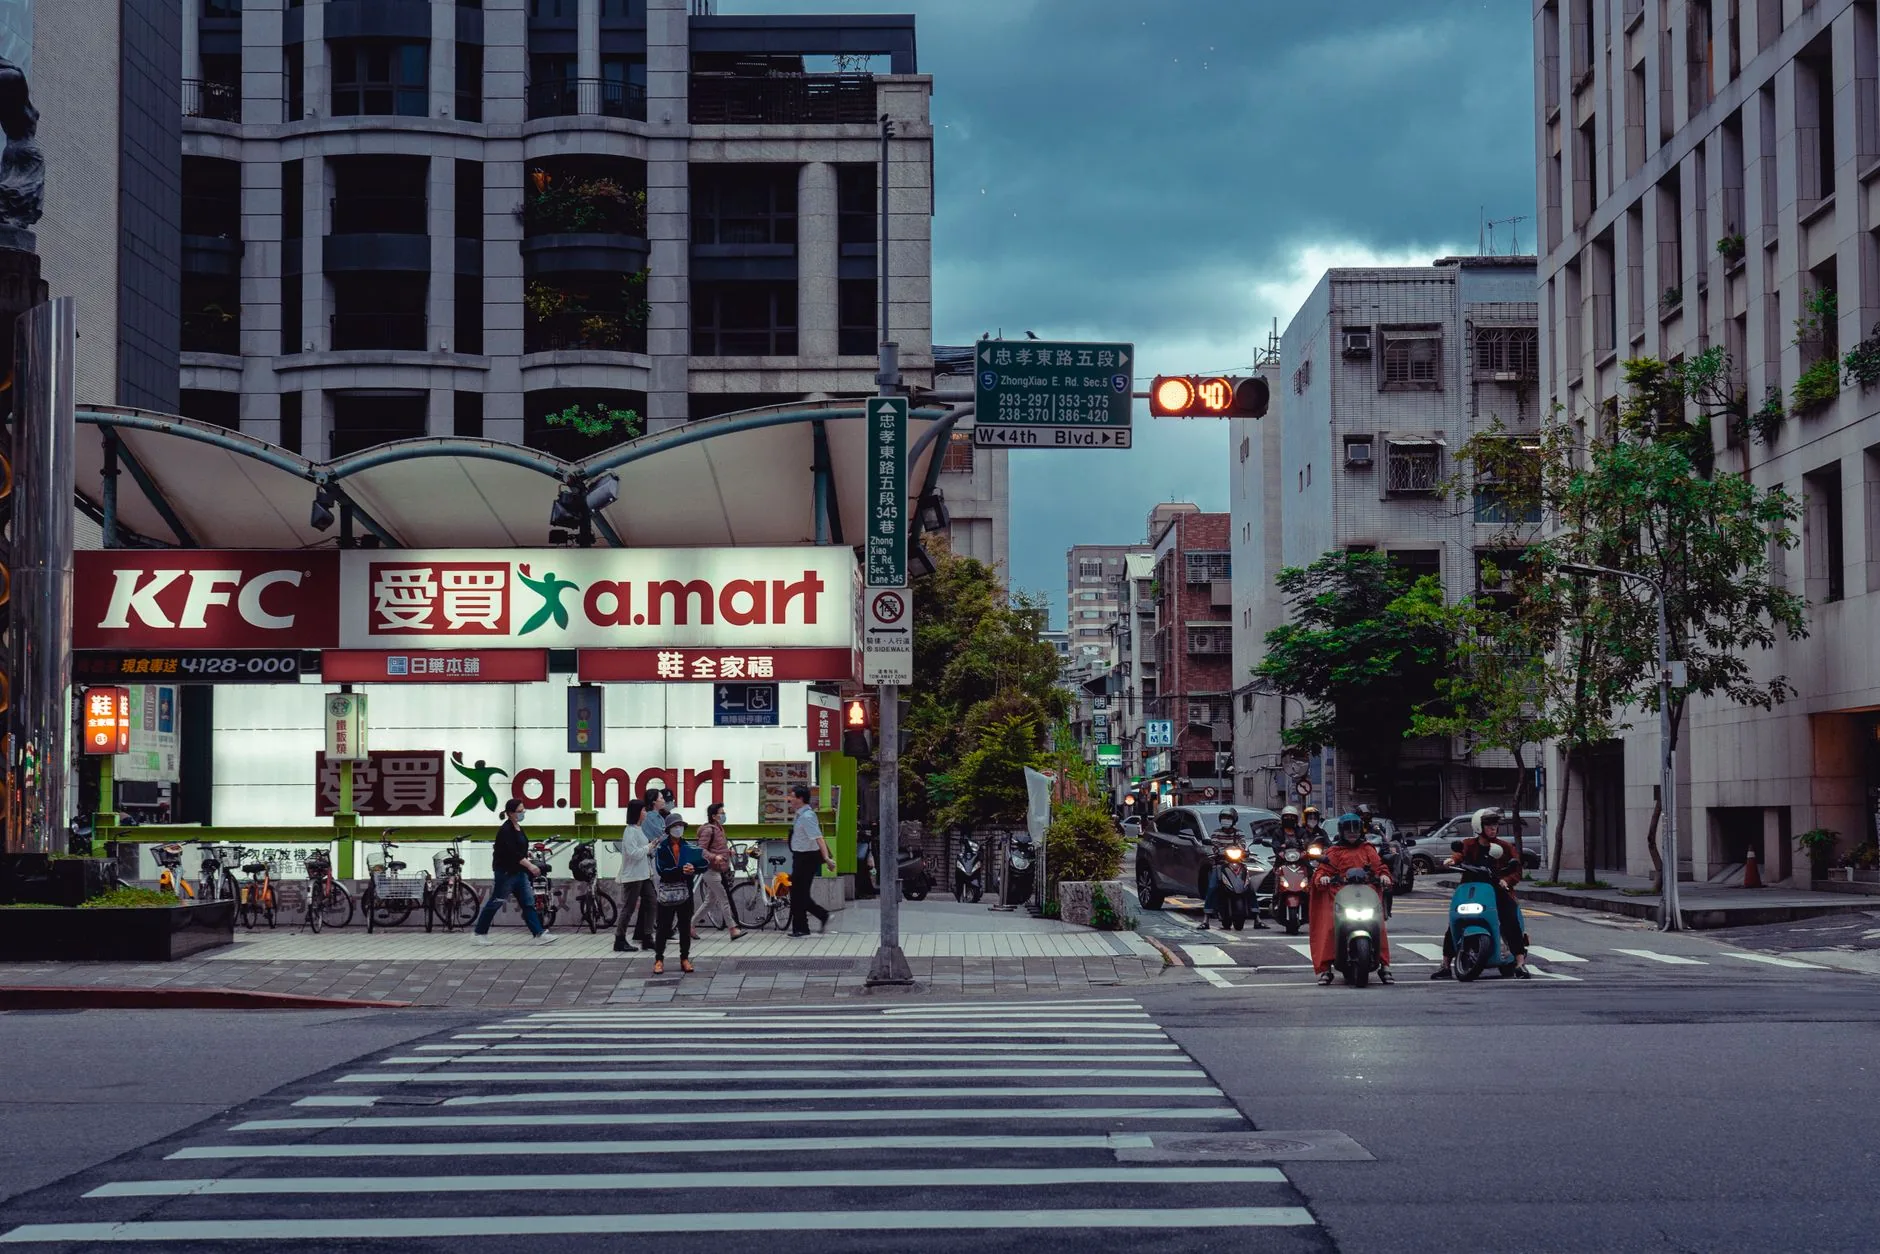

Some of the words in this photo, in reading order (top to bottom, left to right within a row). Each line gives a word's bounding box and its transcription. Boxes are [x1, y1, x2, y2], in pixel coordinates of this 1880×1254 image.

[995, 347, 1115, 367] 忠孝東路五段
[984, 374, 993, 385] 5
[1001, 375, 1048, 388] ZhongXiao
[1051, 376, 1060, 386] E.
[1065, 377, 1079, 386] Rd.
[1115, 378, 1124, 388] 5
[999, 393, 1049, 406] 293-297
[1058, 394, 1109, 408] 353-375
[1199, 383, 1223, 409] 40
[999, 408, 1049, 420] 238-370
[1058, 409, 1109, 422] 386-420
[978, 428, 994, 442] W
[1009, 429, 1037, 443] 4th
[1055, 430, 1099, 444] Blvd.
[1115, 431, 1126, 445] E
[870, 535, 894, 548] Zhong
[870, 546, 887, 555] Xiao
[870, 555, 878, 565] E.
[881, 555, 893, 565] Rd.
[889, 565, 896, 574] 5
[870, 574, 888, 584] Lane
[890, 574, 904, 584] 345
[97, 569, 302, 629] KFC
[373, 567, 508, 631] 愛買
[583, 570, 824, 627] a.mart
[181, 657, 296, 674] 4128-000
[658, 651, 685, 678] 鞋
[691, 655, 774, 679] 全家福
[91, 695, 112, 716] 鞋
[511, 759, 731, 809] a.mart
